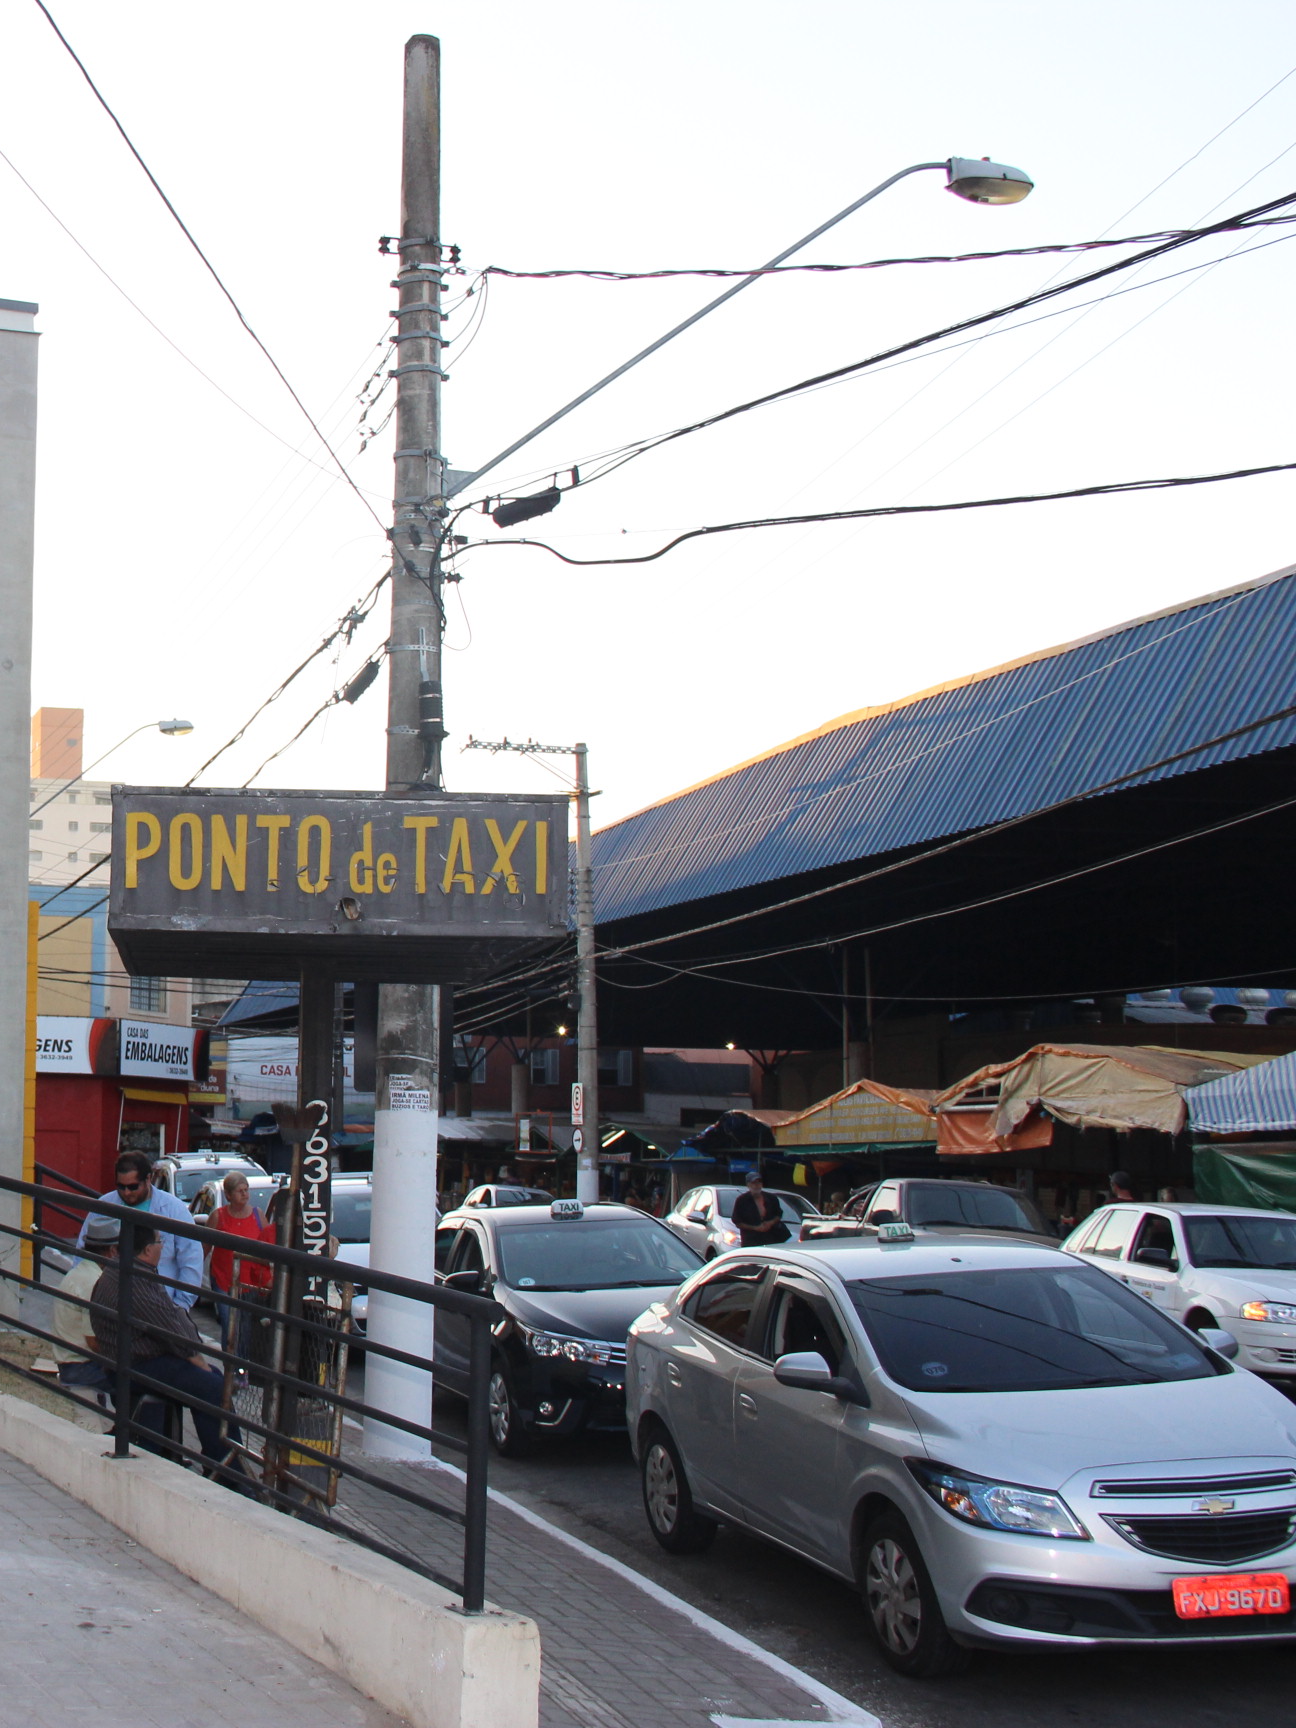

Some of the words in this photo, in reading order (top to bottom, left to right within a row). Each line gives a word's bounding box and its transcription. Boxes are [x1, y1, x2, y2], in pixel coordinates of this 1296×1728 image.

[124, 811, 332, 894] PONTO
[349, 821, 398, 894] de
[404, 815, 548, 895] TAXI
[127, 1027, 139, 1038] CASA
[139, 1028, 149, 1040] DAS
[125, 1040, 189, 1066] EMBALAGENS
[260, 1064, 292, 1076] CASA
[559, 1203, 579, 1212] TAXI
[884, 1226, 909, 1238] TAXI
